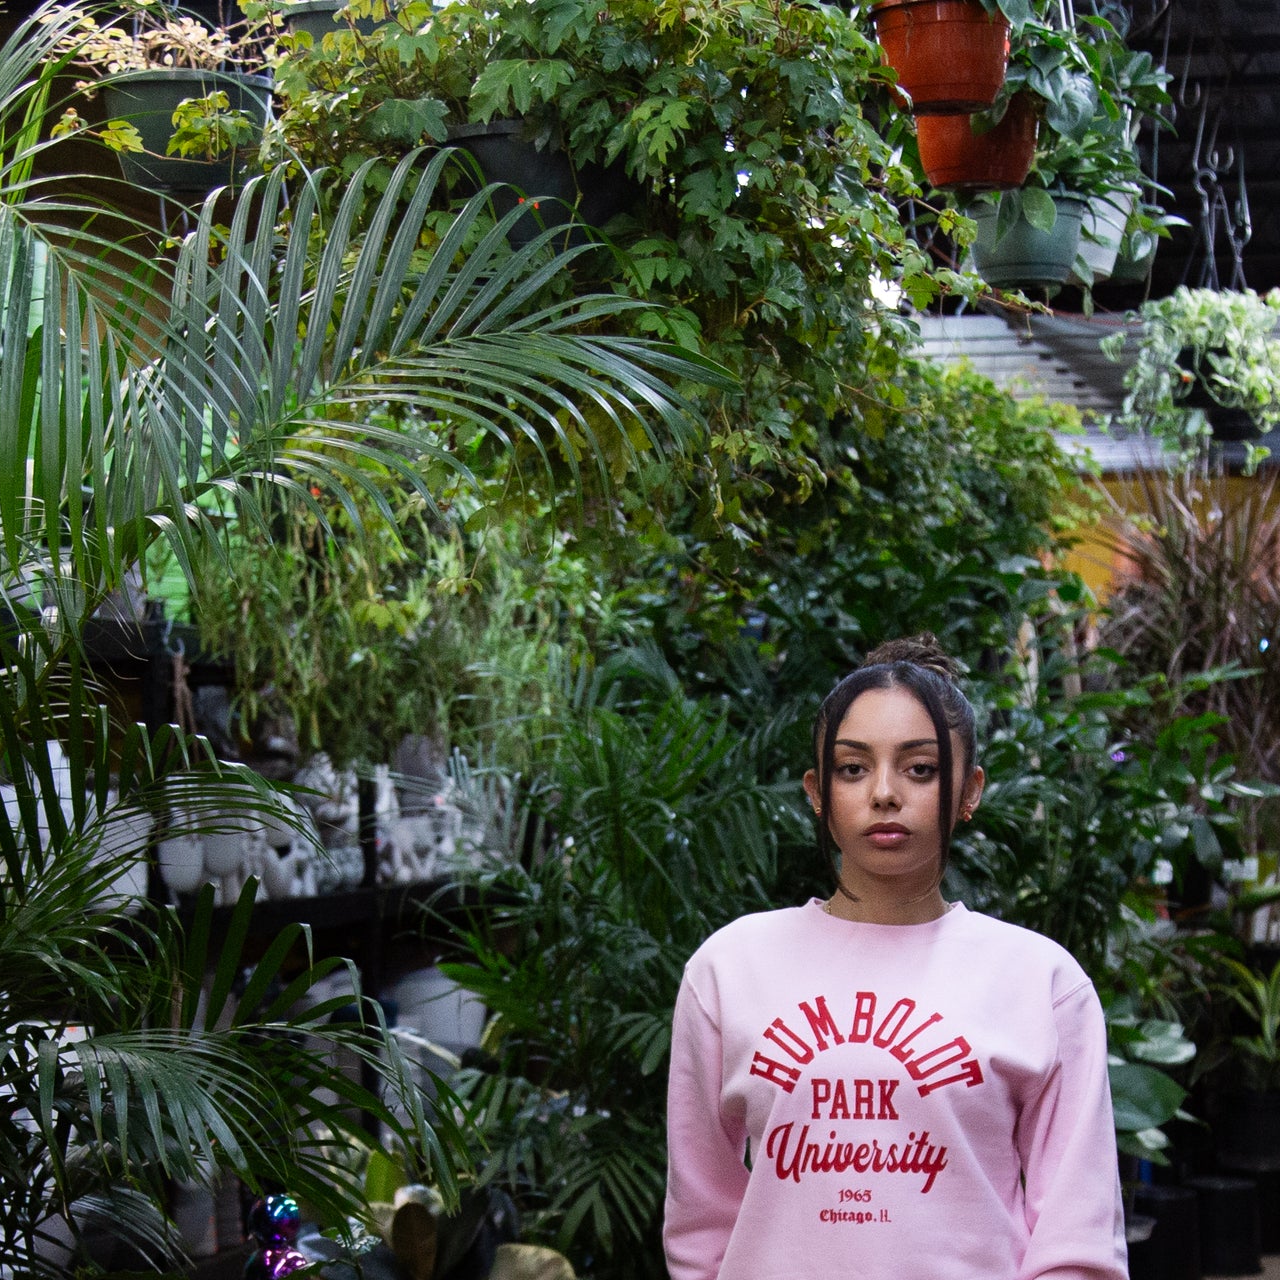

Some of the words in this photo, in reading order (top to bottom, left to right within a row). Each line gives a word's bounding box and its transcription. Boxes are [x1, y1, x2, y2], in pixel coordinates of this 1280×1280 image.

[749, 992, 984, 1098] HUMBOLDT
[811, 1079, 899, 1120] PARK
[766, 1121, 948, 1194] University
[838, 1189, 872, 1203] 1965
